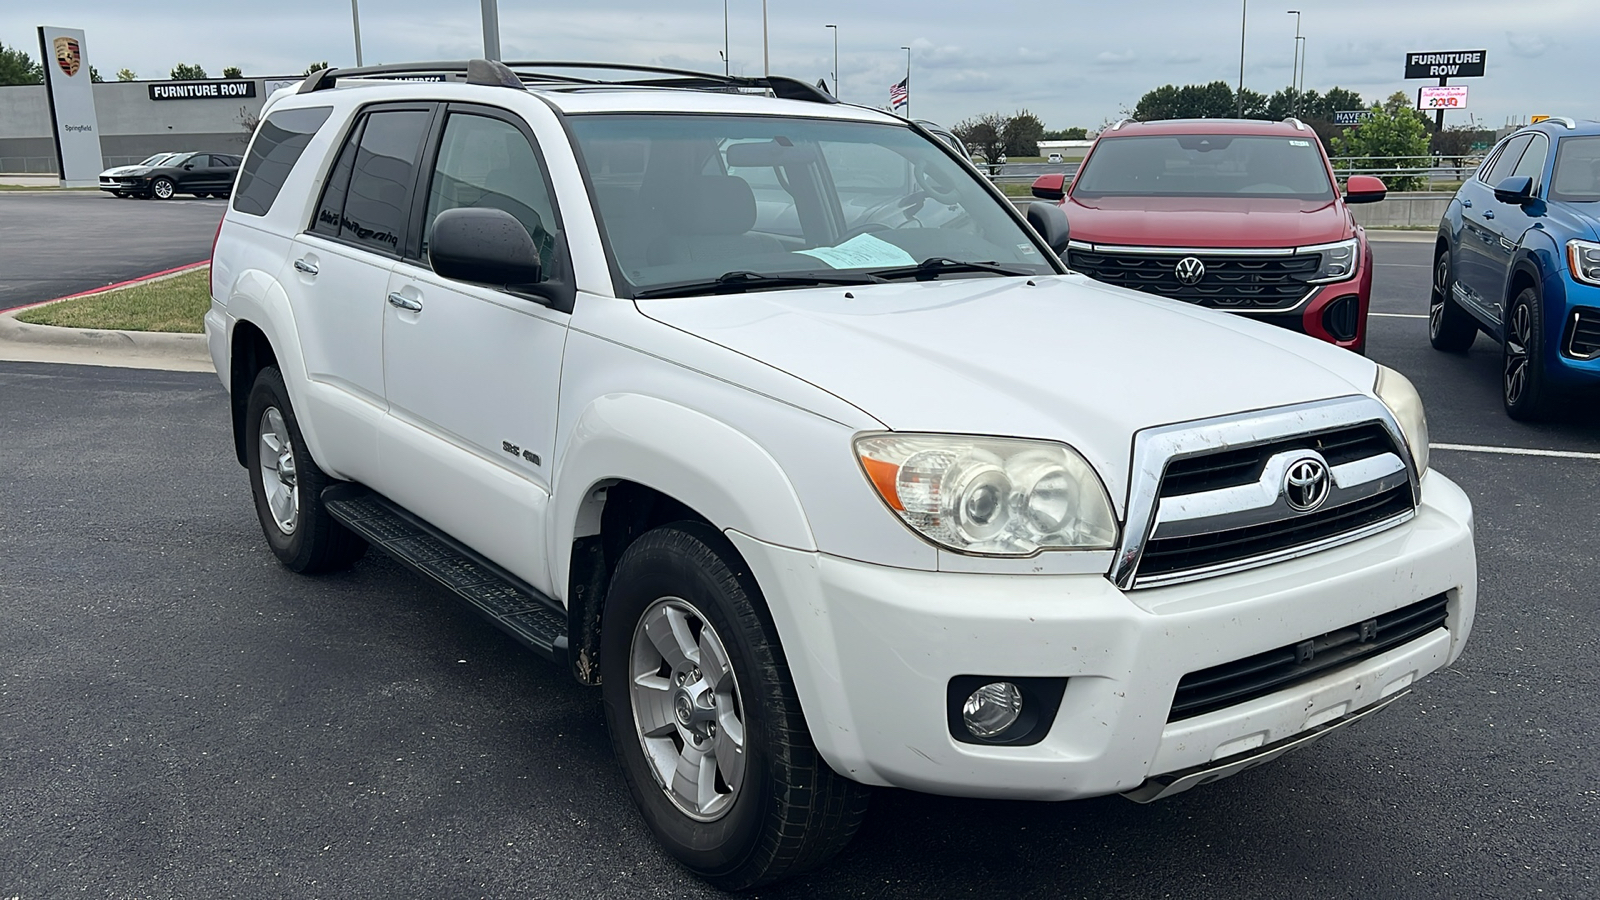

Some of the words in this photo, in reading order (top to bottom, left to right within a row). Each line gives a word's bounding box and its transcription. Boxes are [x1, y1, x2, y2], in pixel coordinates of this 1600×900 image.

[1411, 53, 1481, 65] FURNITURE
[1430, 65, 1459, 76] ROW
[154, 84, 218, 98] FURNITURE
[221, 83, 247, 96] ROW
[64, 123, 92, 133] Springfield
